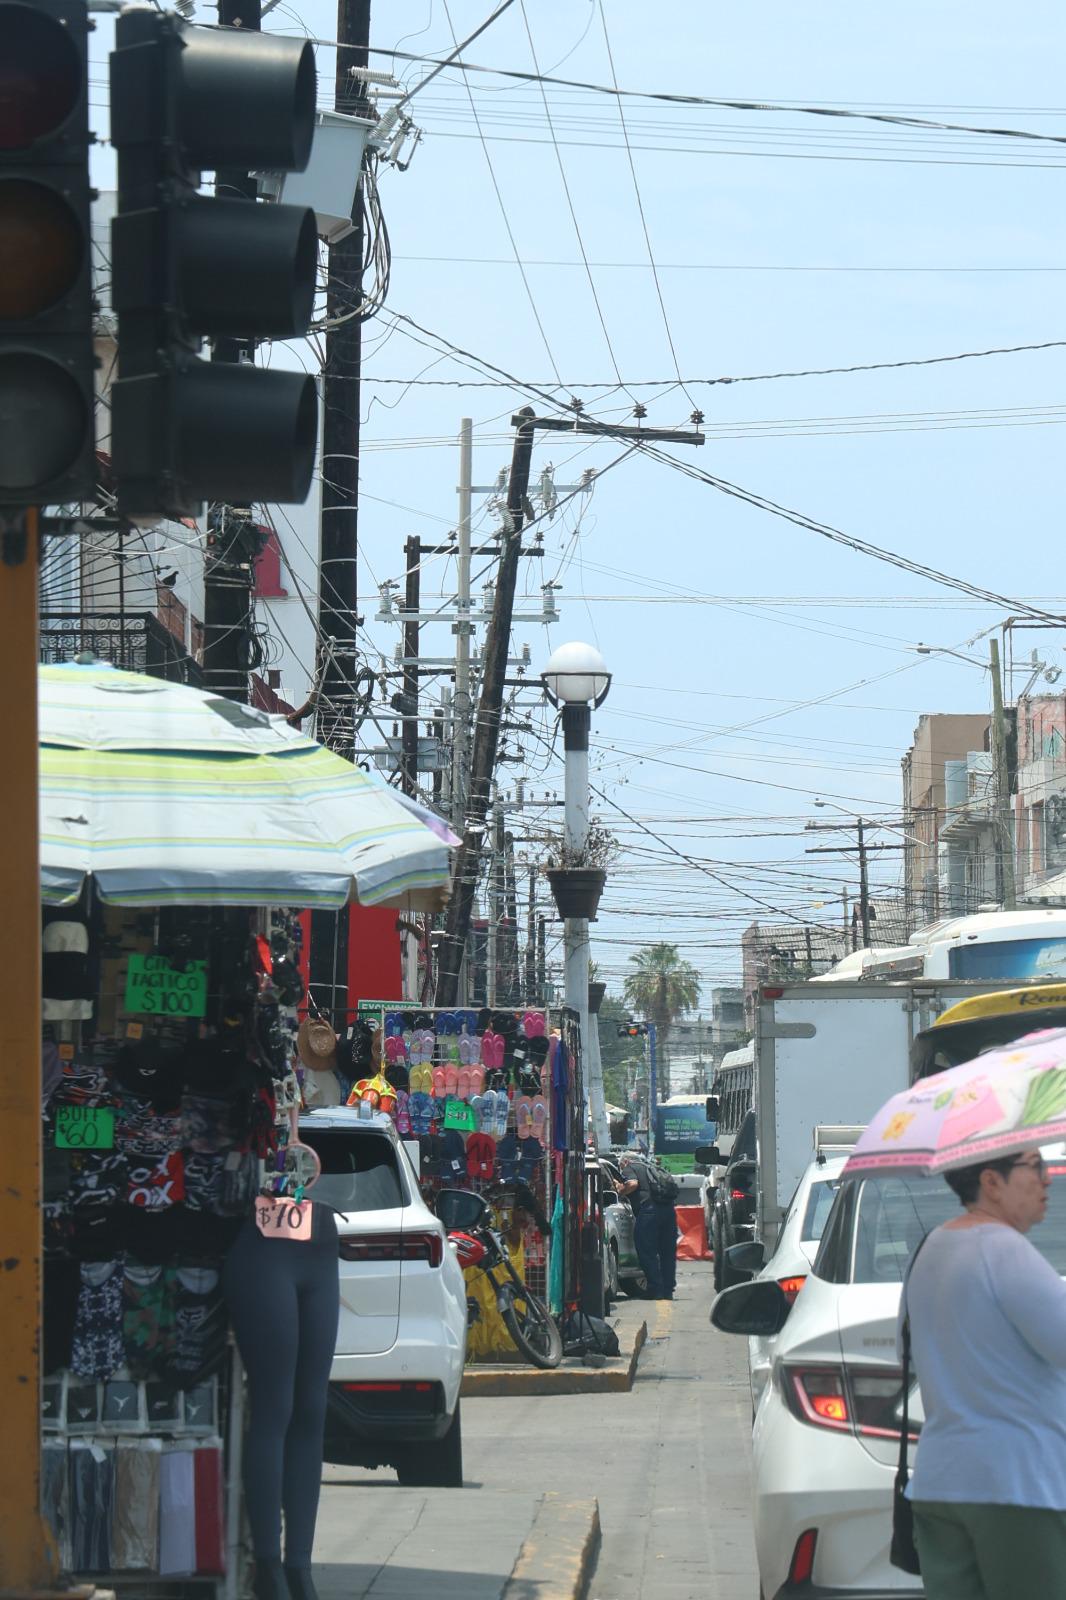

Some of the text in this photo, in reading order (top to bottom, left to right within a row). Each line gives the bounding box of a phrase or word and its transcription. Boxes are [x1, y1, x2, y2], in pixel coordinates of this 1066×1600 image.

[144, 955, 197, 973] CIO
[60, 1122, 98, 1146] $60
[259, 1204, 302, 1229] $70
